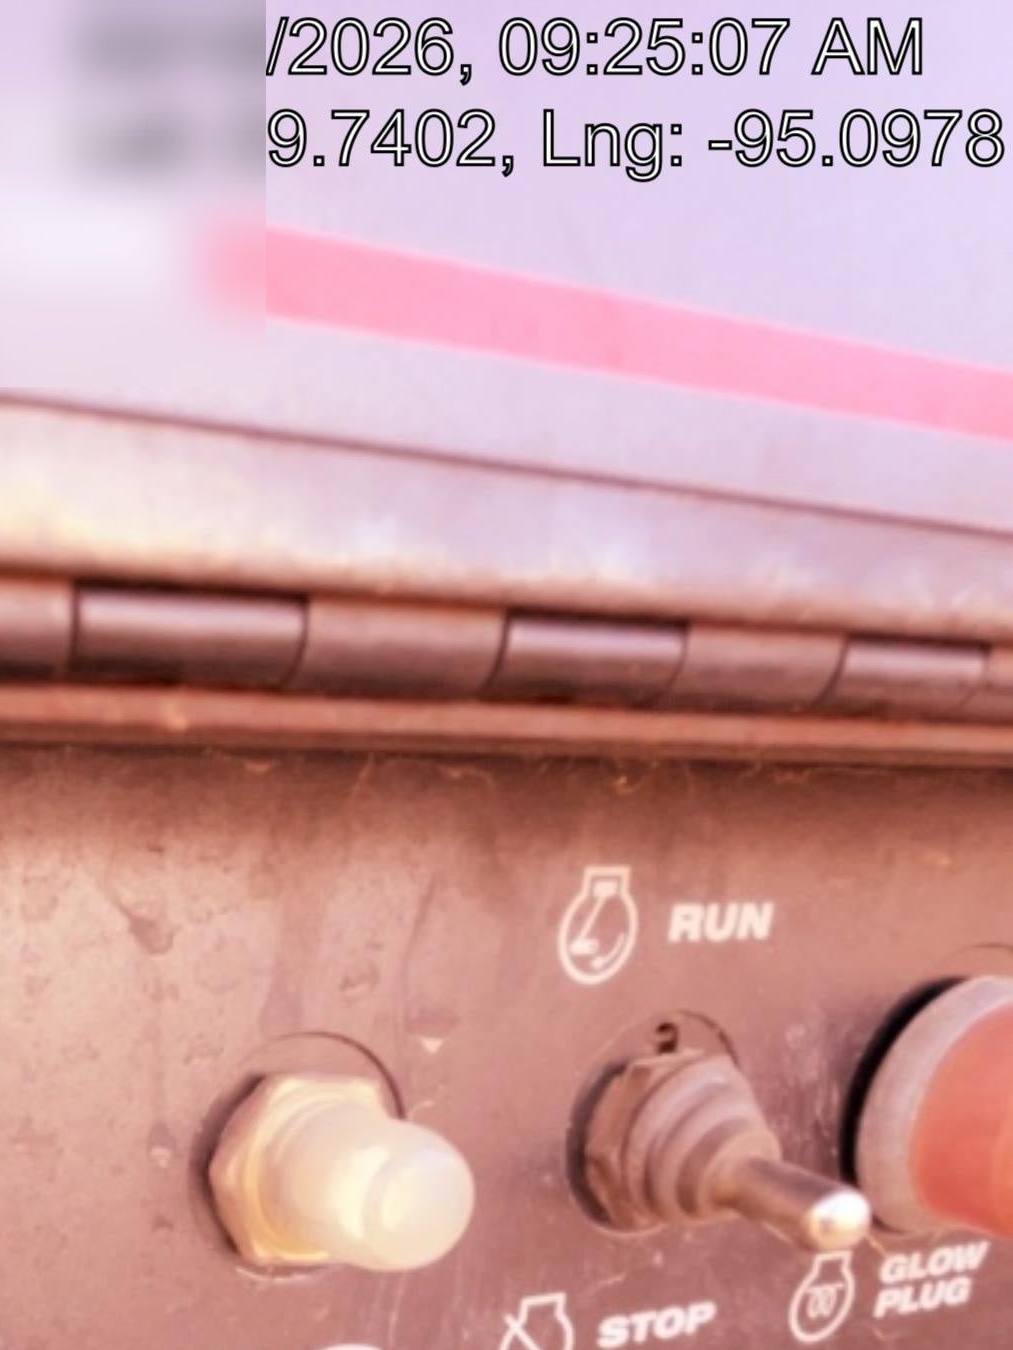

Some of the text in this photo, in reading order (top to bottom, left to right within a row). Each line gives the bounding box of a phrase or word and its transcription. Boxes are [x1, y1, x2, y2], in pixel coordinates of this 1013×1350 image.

[667, 901, 775, 944] RUN
[879, 1241, 990, 1287] GLOW
[874, 1276, 973, 1320] PLUG
[596, 1301, 717, 1350] STOP
